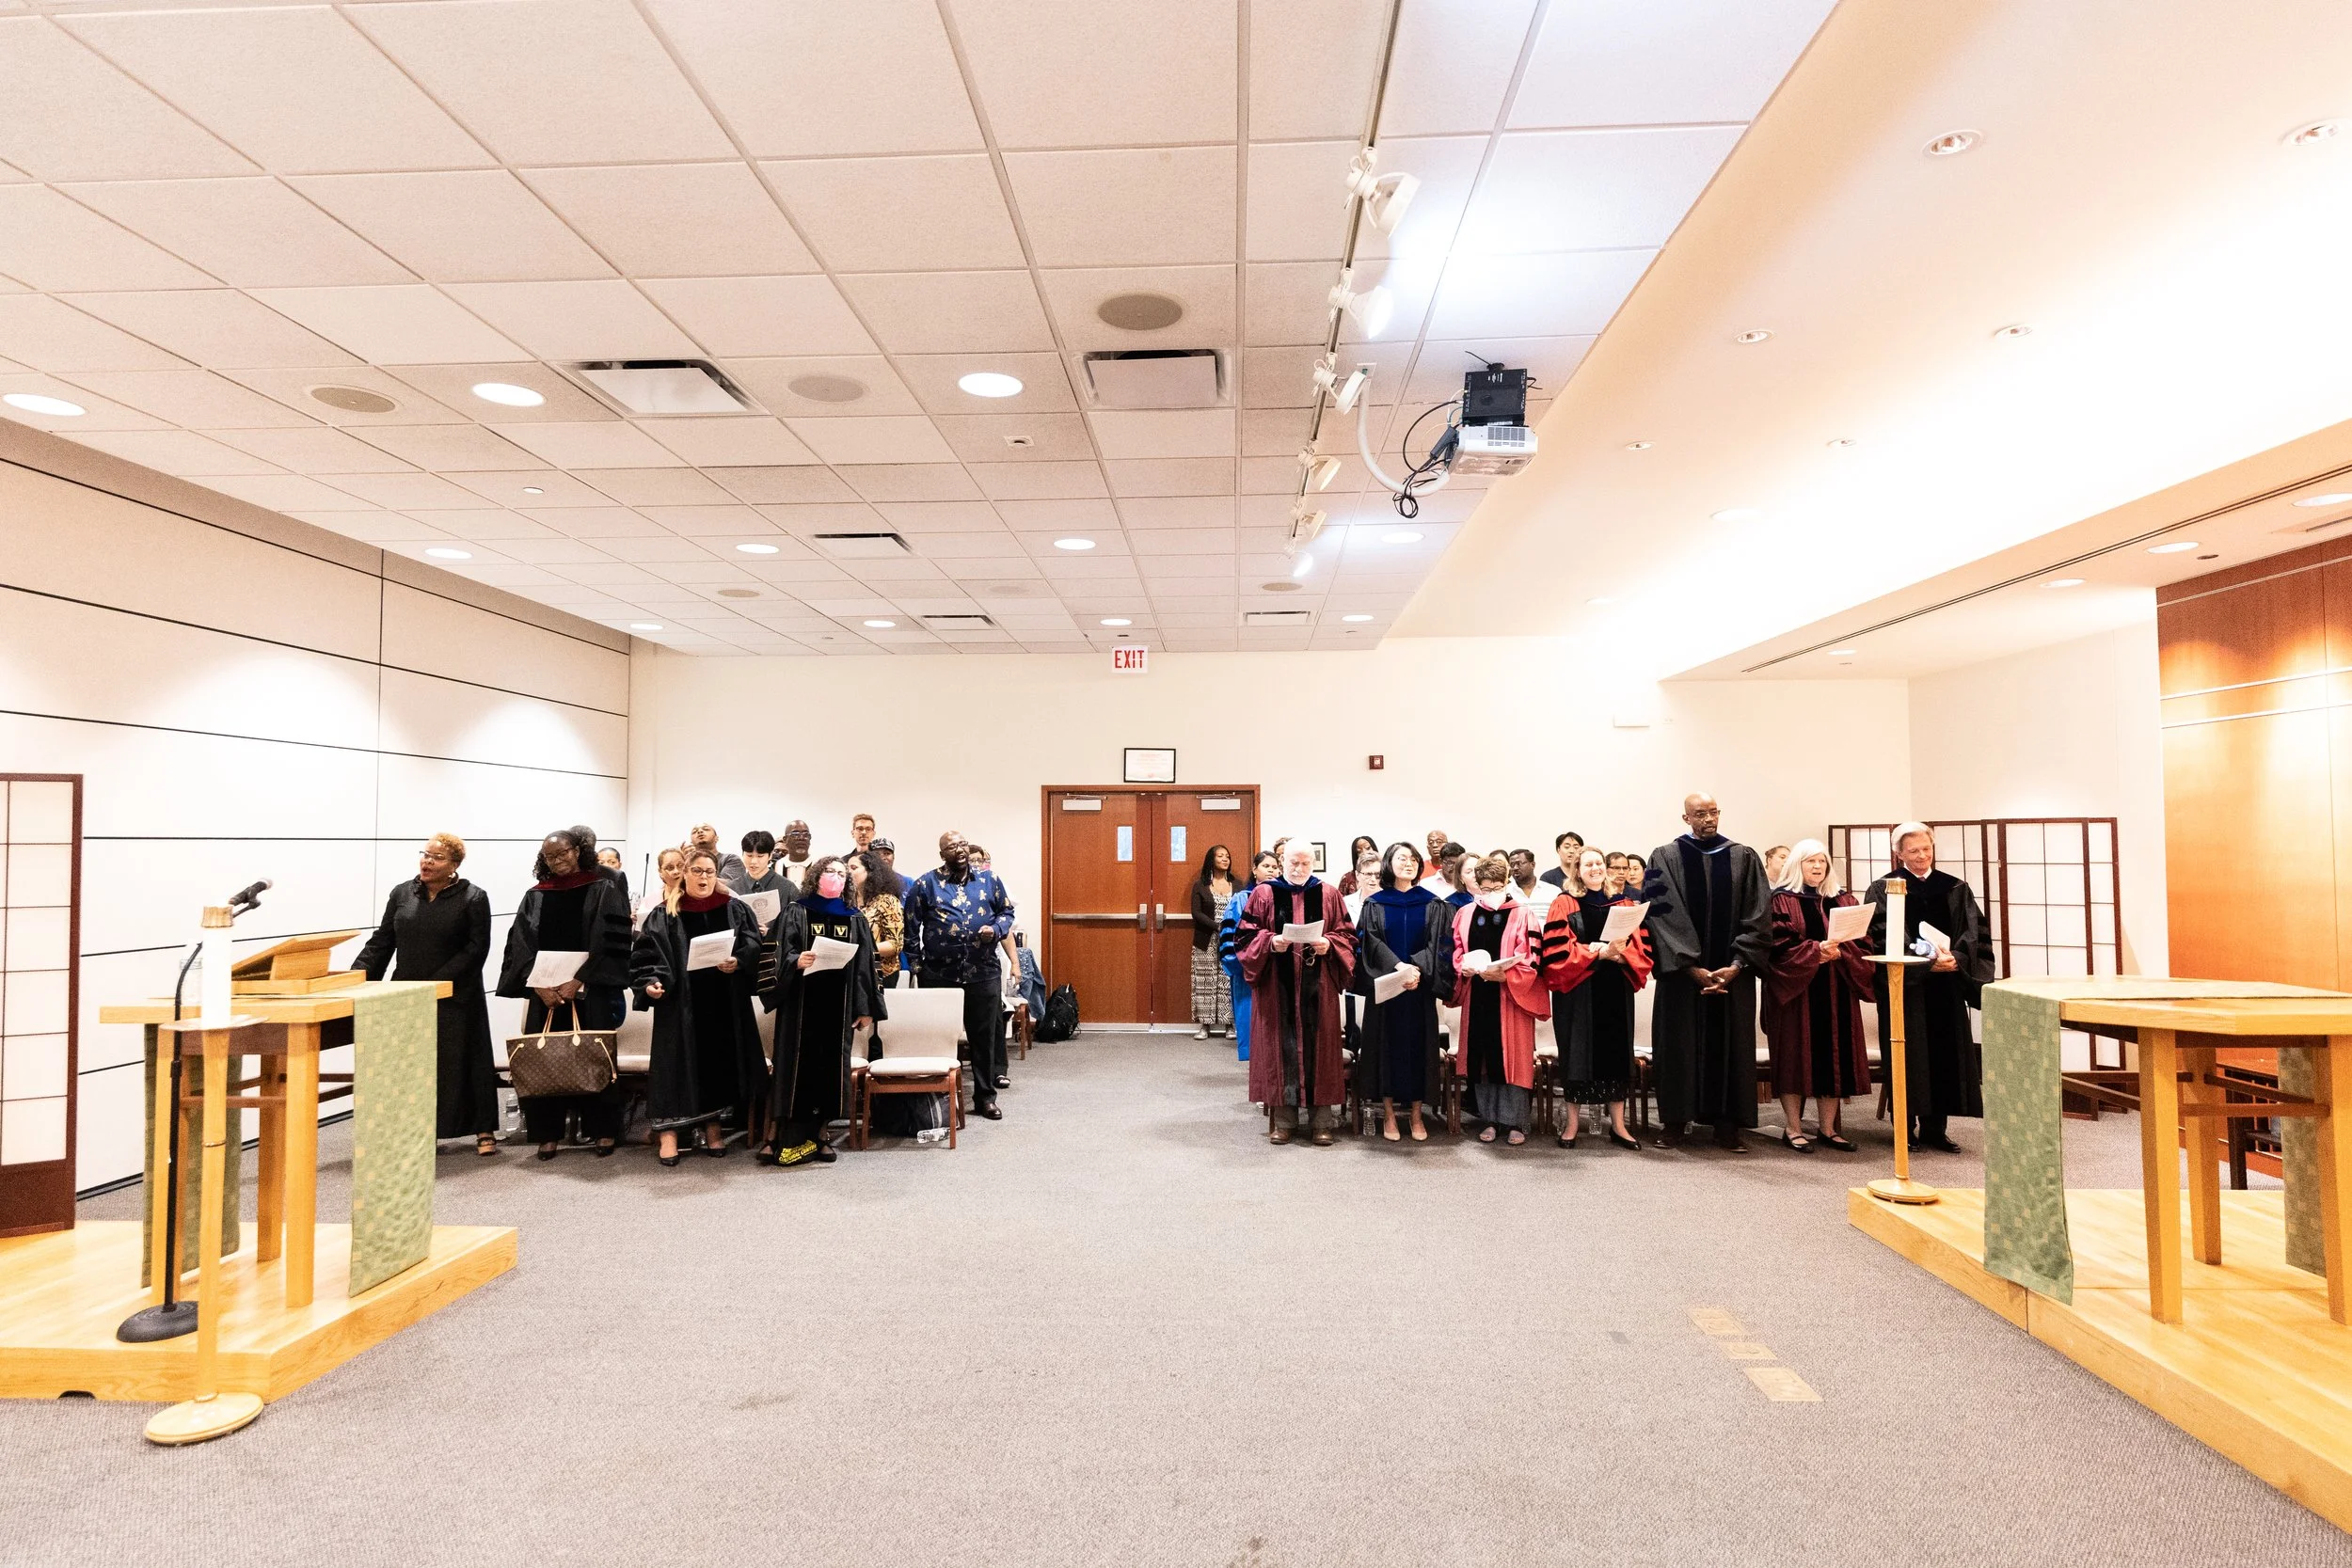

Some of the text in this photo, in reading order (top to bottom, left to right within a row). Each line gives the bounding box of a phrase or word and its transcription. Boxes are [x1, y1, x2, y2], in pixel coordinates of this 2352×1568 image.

[1115, 650, 1144, 668] EXIT
[813, 925, 823, 934] V
[835, 927, 846, 936] V
